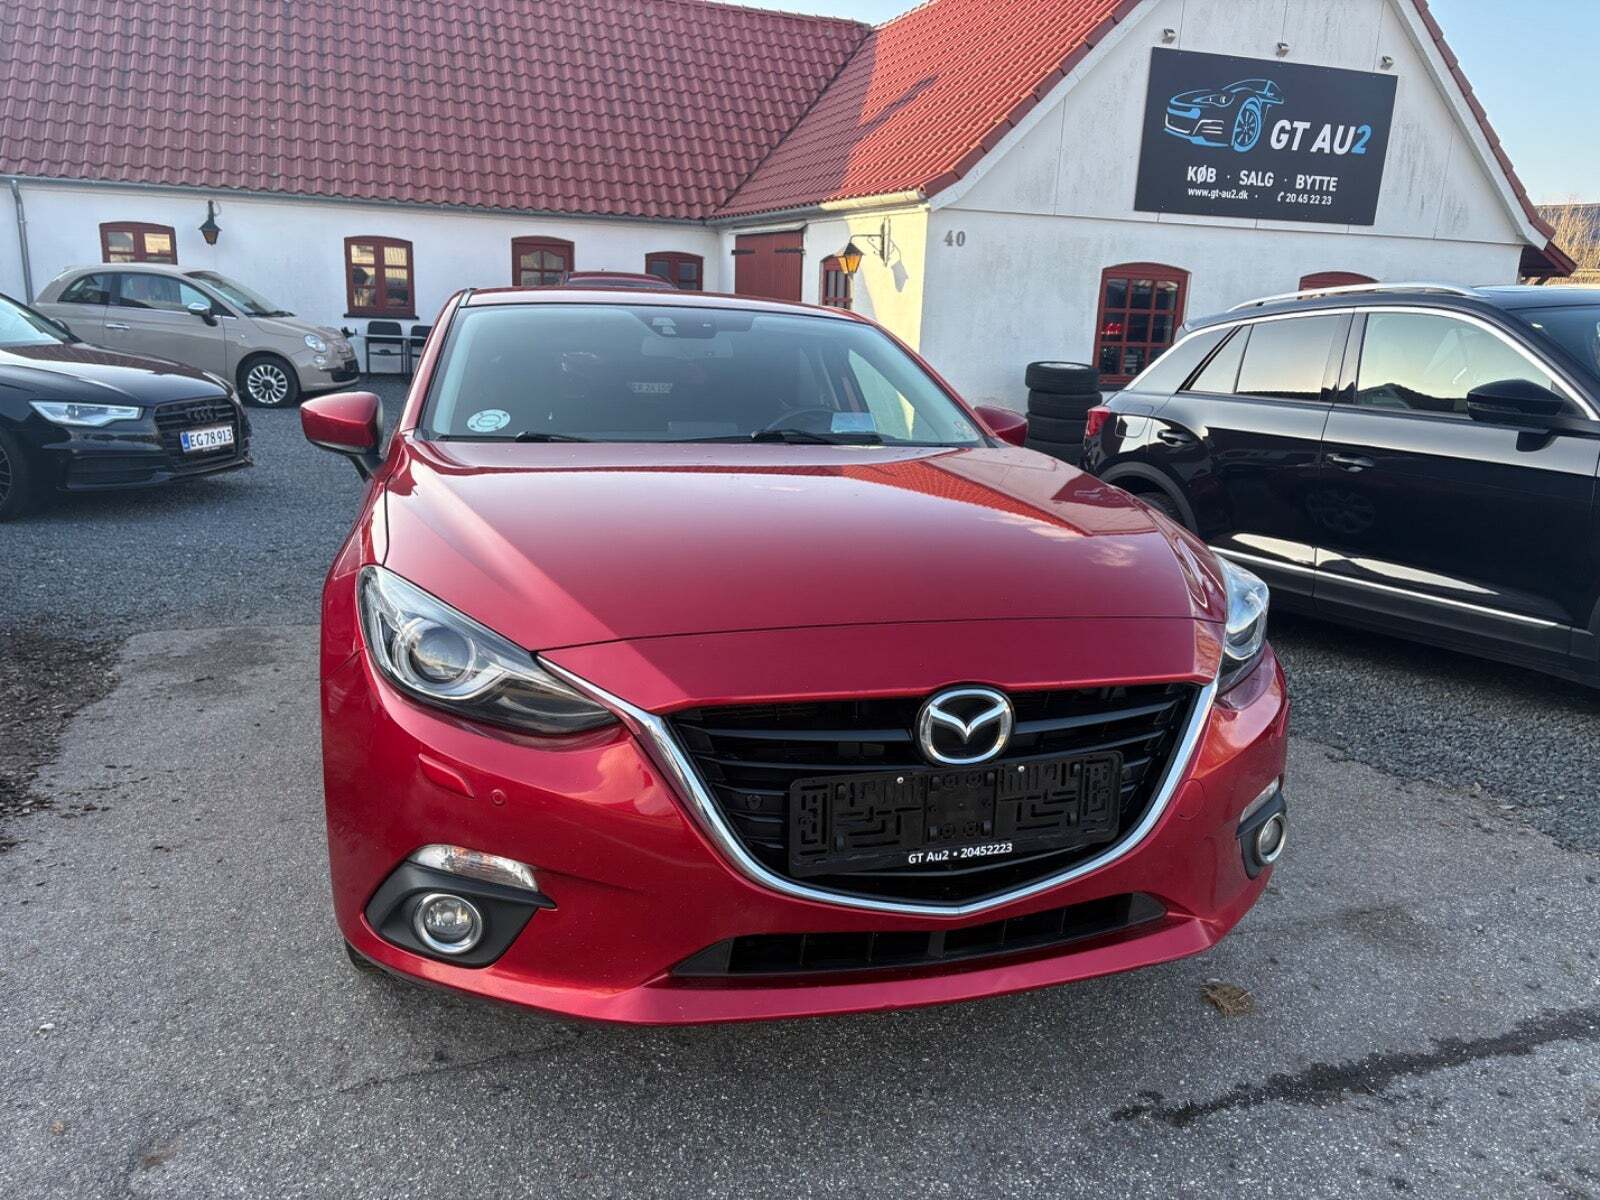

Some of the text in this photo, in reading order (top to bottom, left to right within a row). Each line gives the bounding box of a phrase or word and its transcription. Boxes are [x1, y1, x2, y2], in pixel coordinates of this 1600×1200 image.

[1270, 119, 1372, 155] GT AU2
[1186, 164, 1338, 192] KØB SALG BYTTE
[1188, 187, 1332, 205] www.gt-au2.dk 20 45 22 23
[943, 229, 966, 247] 40
[908, 843, 1013, 864] GT Au2 20452223
